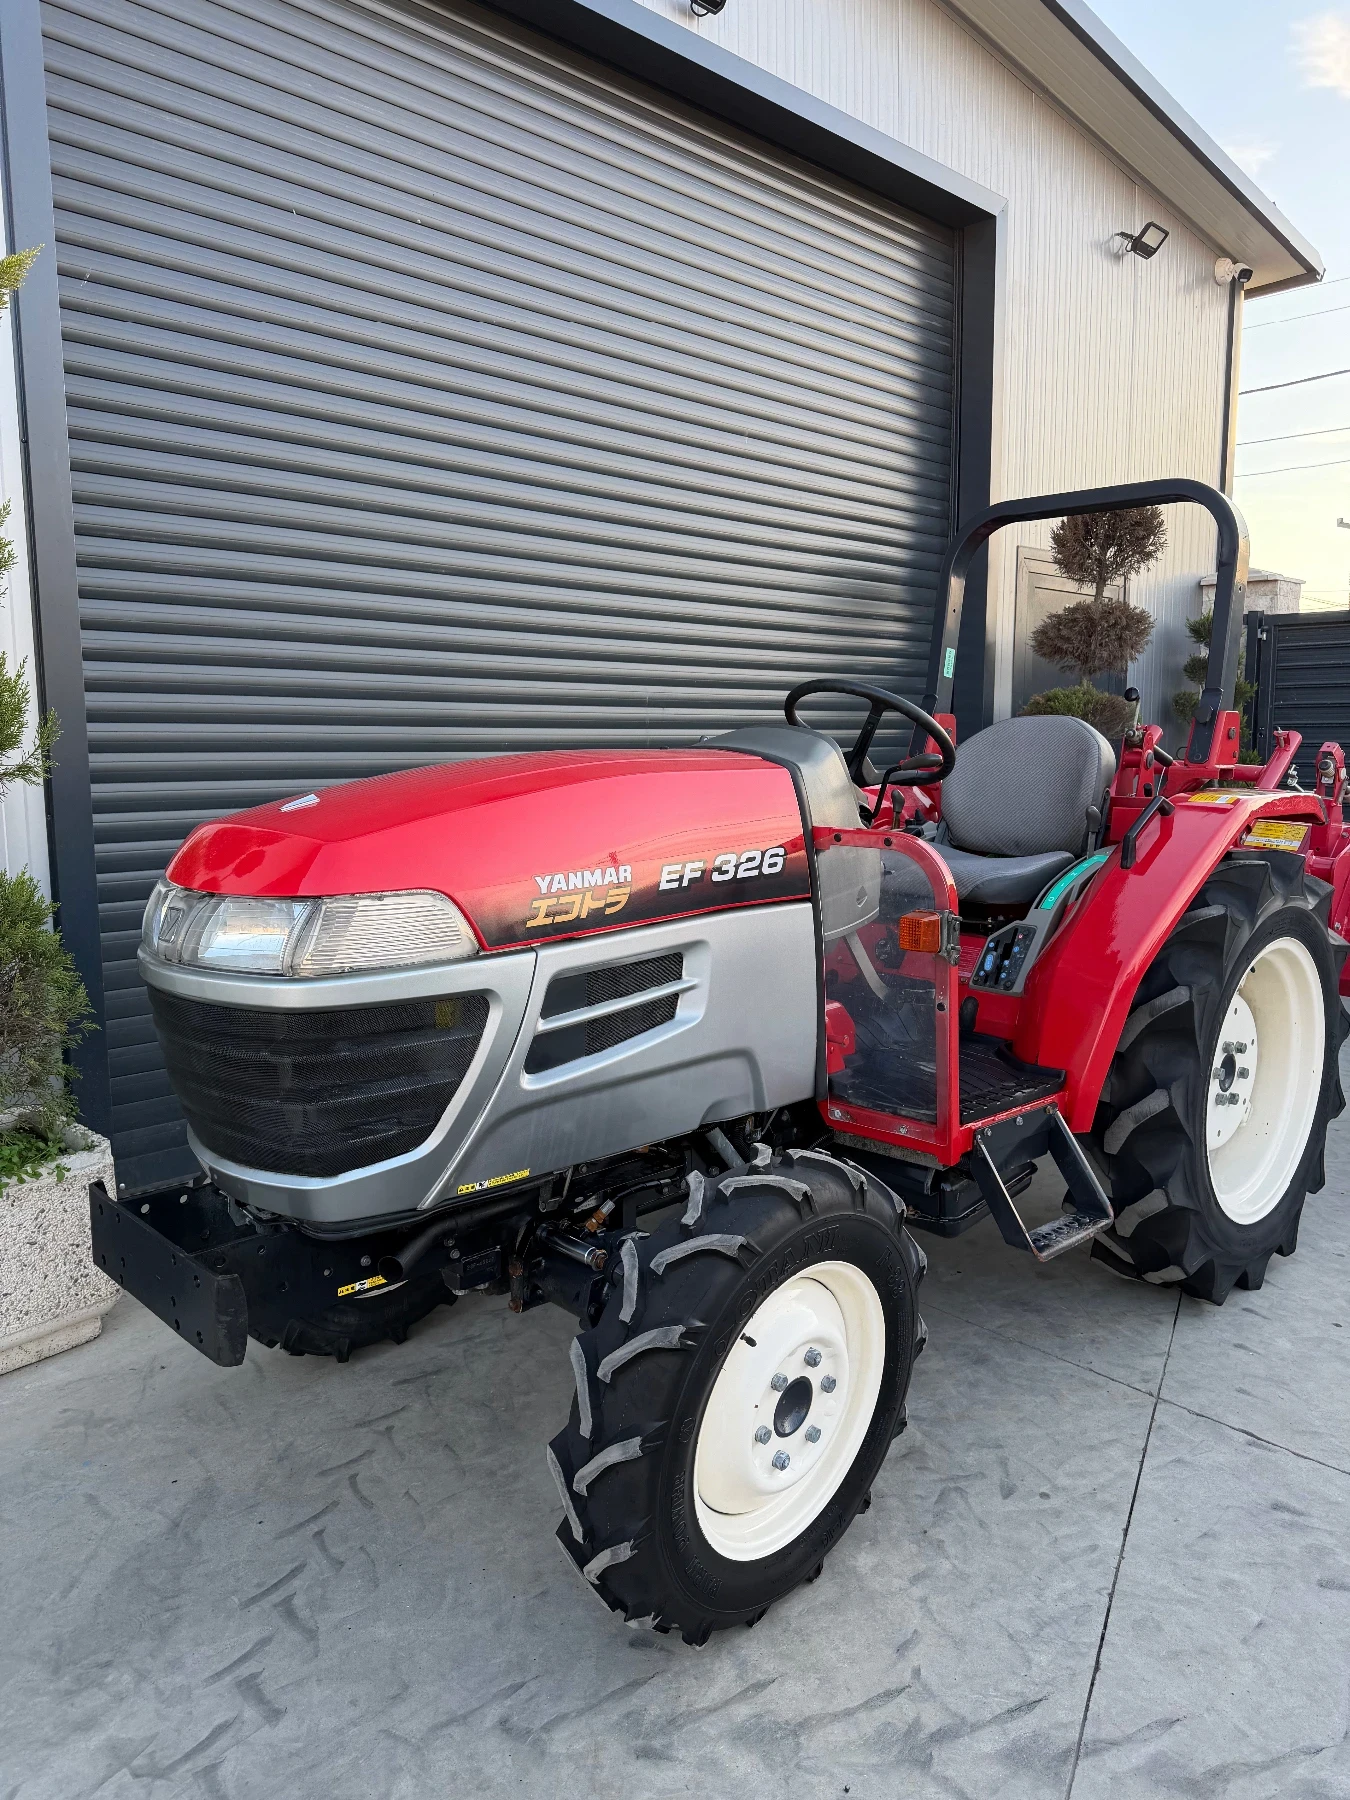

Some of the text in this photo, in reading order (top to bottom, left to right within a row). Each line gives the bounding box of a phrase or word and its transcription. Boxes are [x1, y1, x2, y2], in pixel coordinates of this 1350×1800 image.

[535, 865, 632, 894] YANMAR
[659, 848, 786, 890] EF 326
[526, 887, 632, 928] エコトラ
